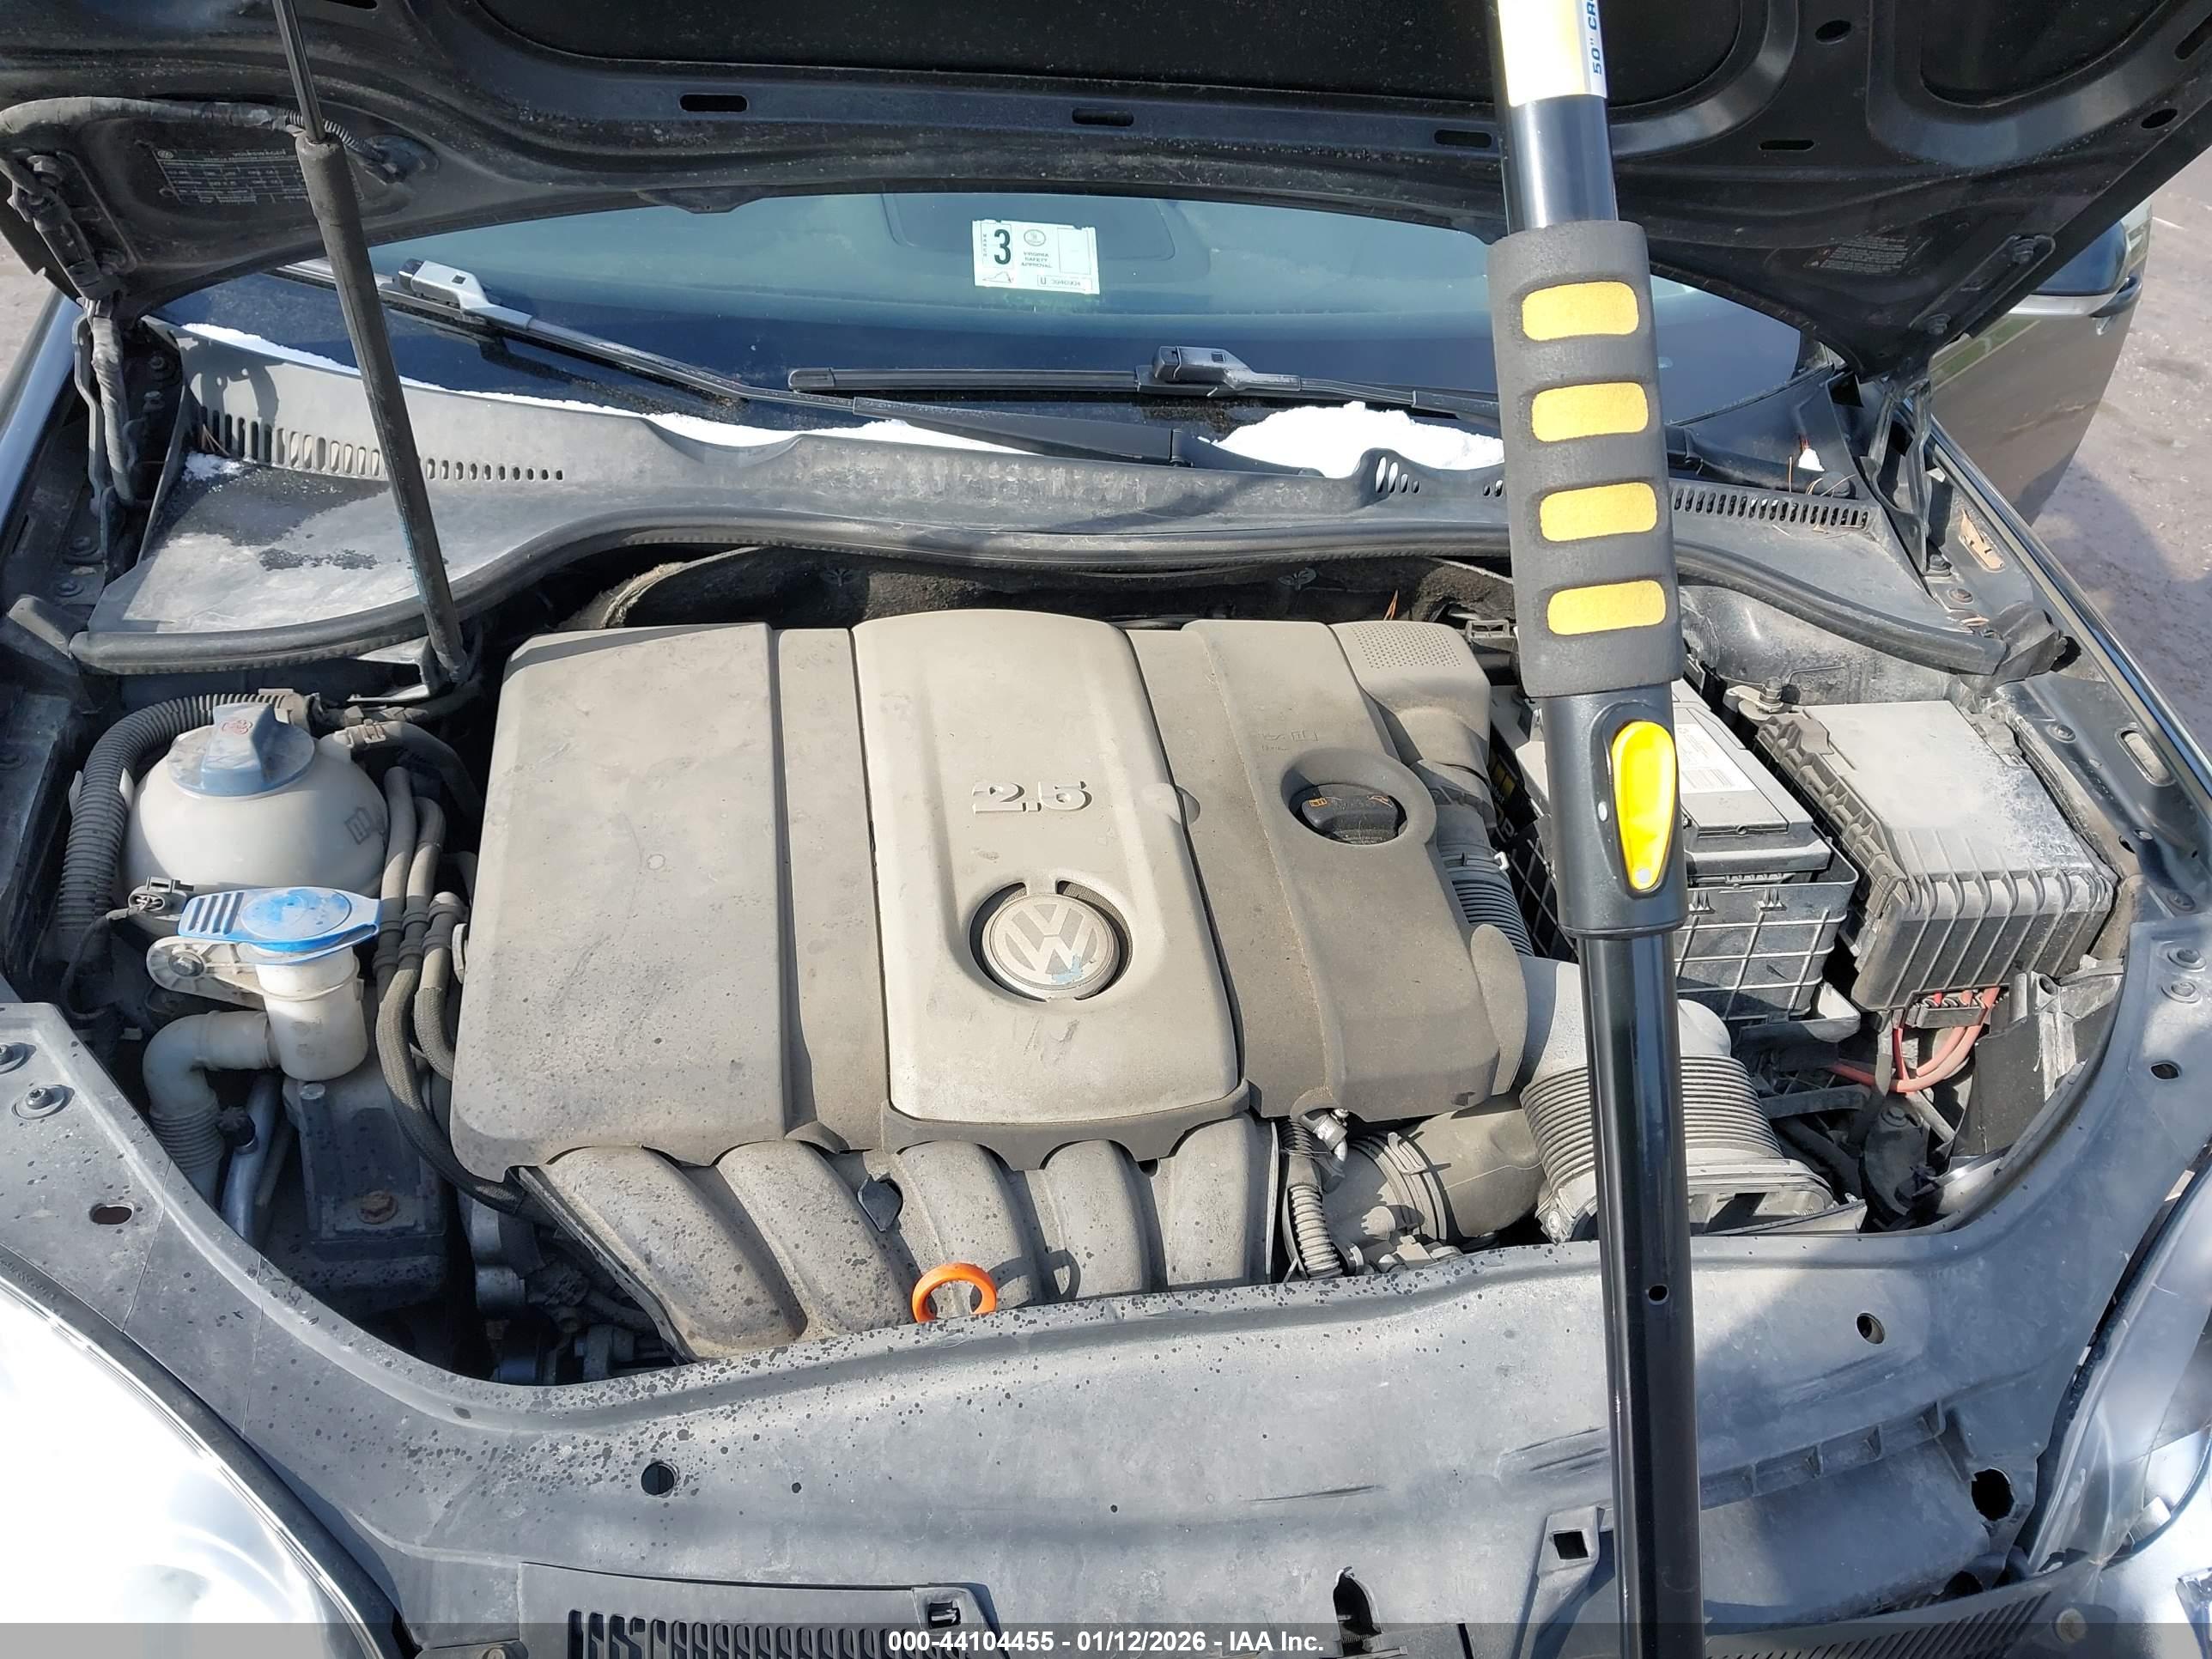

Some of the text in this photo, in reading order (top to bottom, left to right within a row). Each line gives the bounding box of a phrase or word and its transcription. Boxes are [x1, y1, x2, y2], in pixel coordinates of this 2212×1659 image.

[1586, 0, 1602, 76] 50" CR
[994, 228, 1012, 265] 3
[1040, 276, 1047, 285] U
[972, 780, 1093, 813] 2.5
[989, 894, 1113, 990] VW
